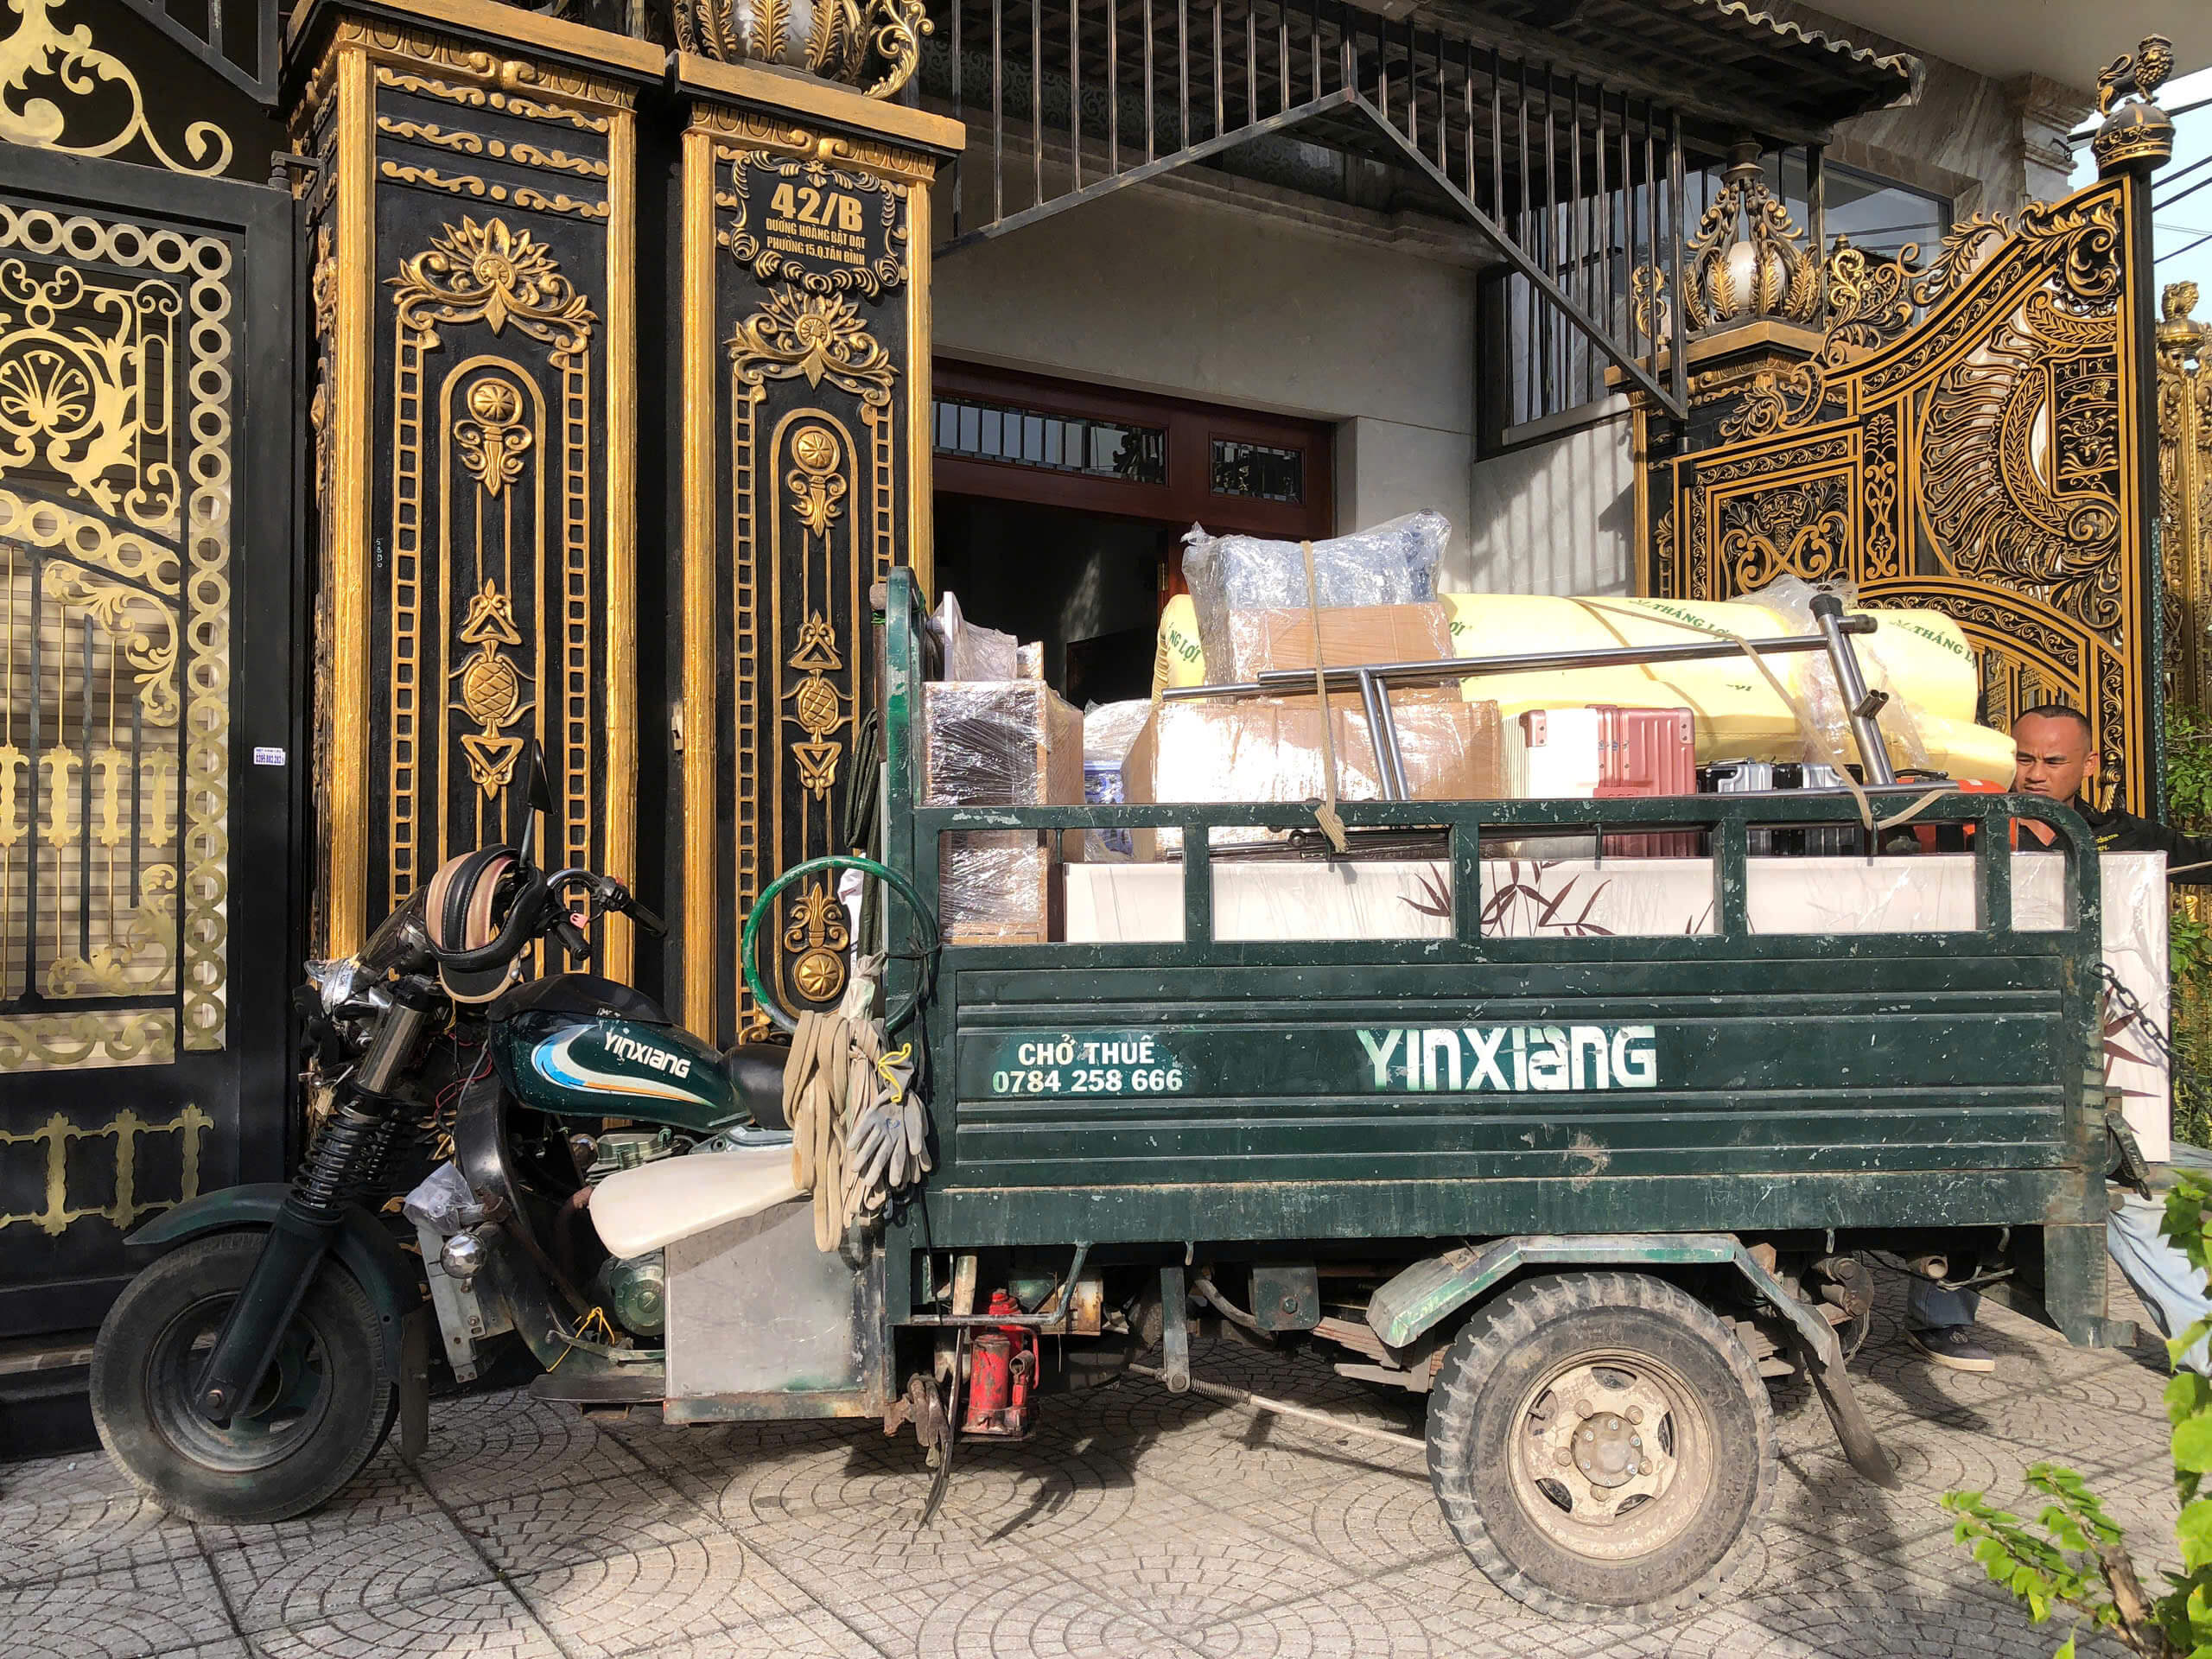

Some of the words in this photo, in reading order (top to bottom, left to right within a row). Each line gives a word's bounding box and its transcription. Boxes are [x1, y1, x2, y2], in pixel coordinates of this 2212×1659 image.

[771, 182, 862, 232] 42/B
[798, 224, 830, 242] HOÀNG
[1018, 1033, 1077, 1065] CHỞ
[1083, 1035, 1155, 1065] THUÊ
[993, 1070, 1061, 1092] 0784
[1071, 1070, 1123, 1092] 258
[1131, 1069, 1183, 1091] 666
